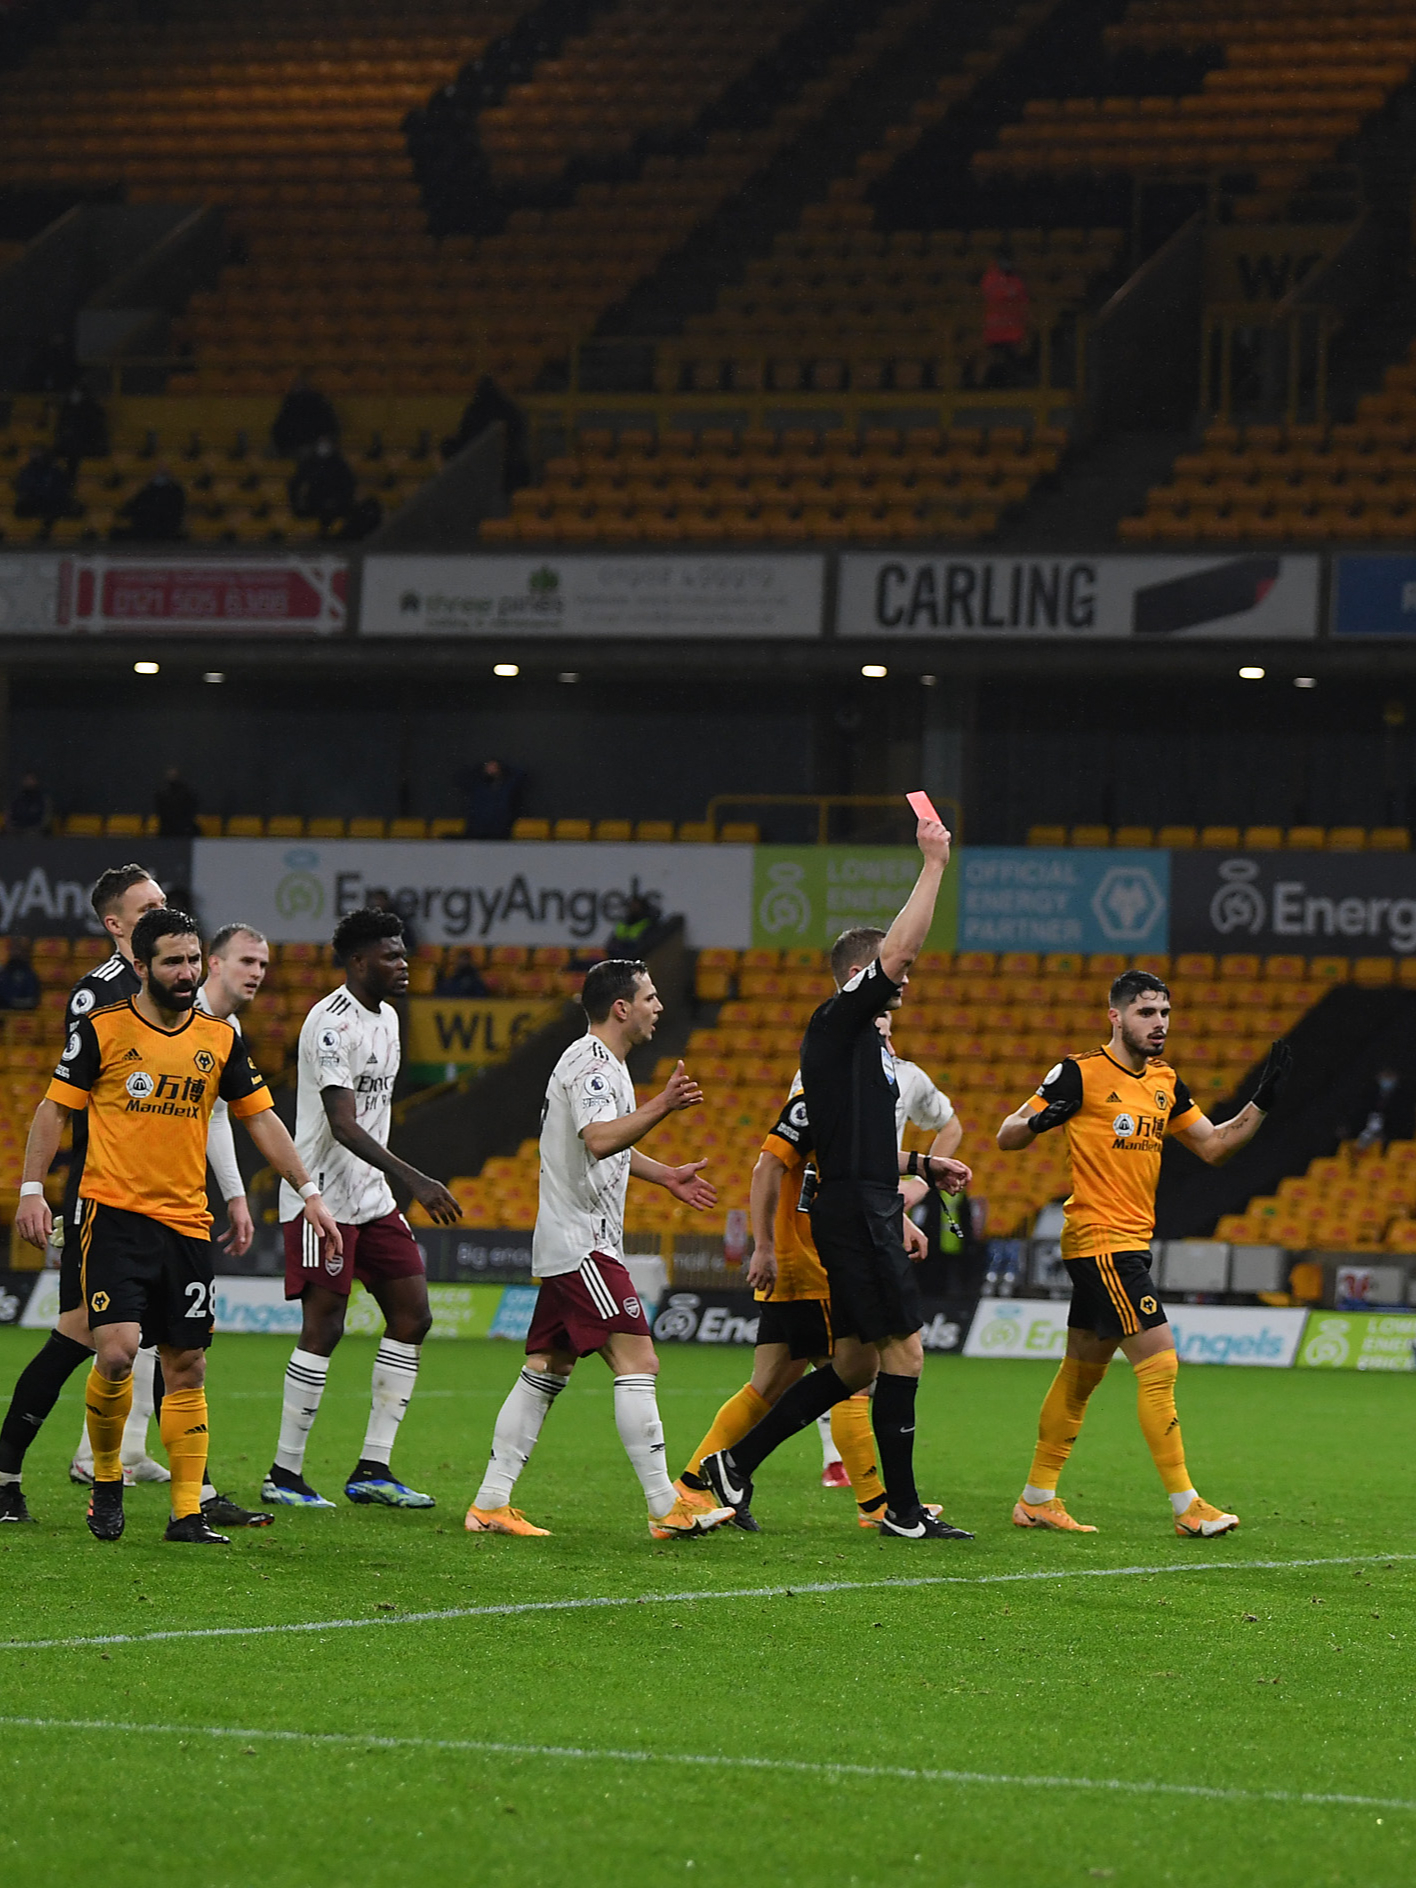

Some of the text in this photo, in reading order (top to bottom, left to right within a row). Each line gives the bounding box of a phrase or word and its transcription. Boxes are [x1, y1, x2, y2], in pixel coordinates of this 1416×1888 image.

[876, 564, 1097, 628] CARLING
[827, 887, 911, 911] ENERG
[965, 888, 1070, 912] ENERGY
[963, 917, 1083, 943] PARTNER
[155, 1073, 206, 1104] 万博
[126, 1099, 200, 1119] ManBetX
